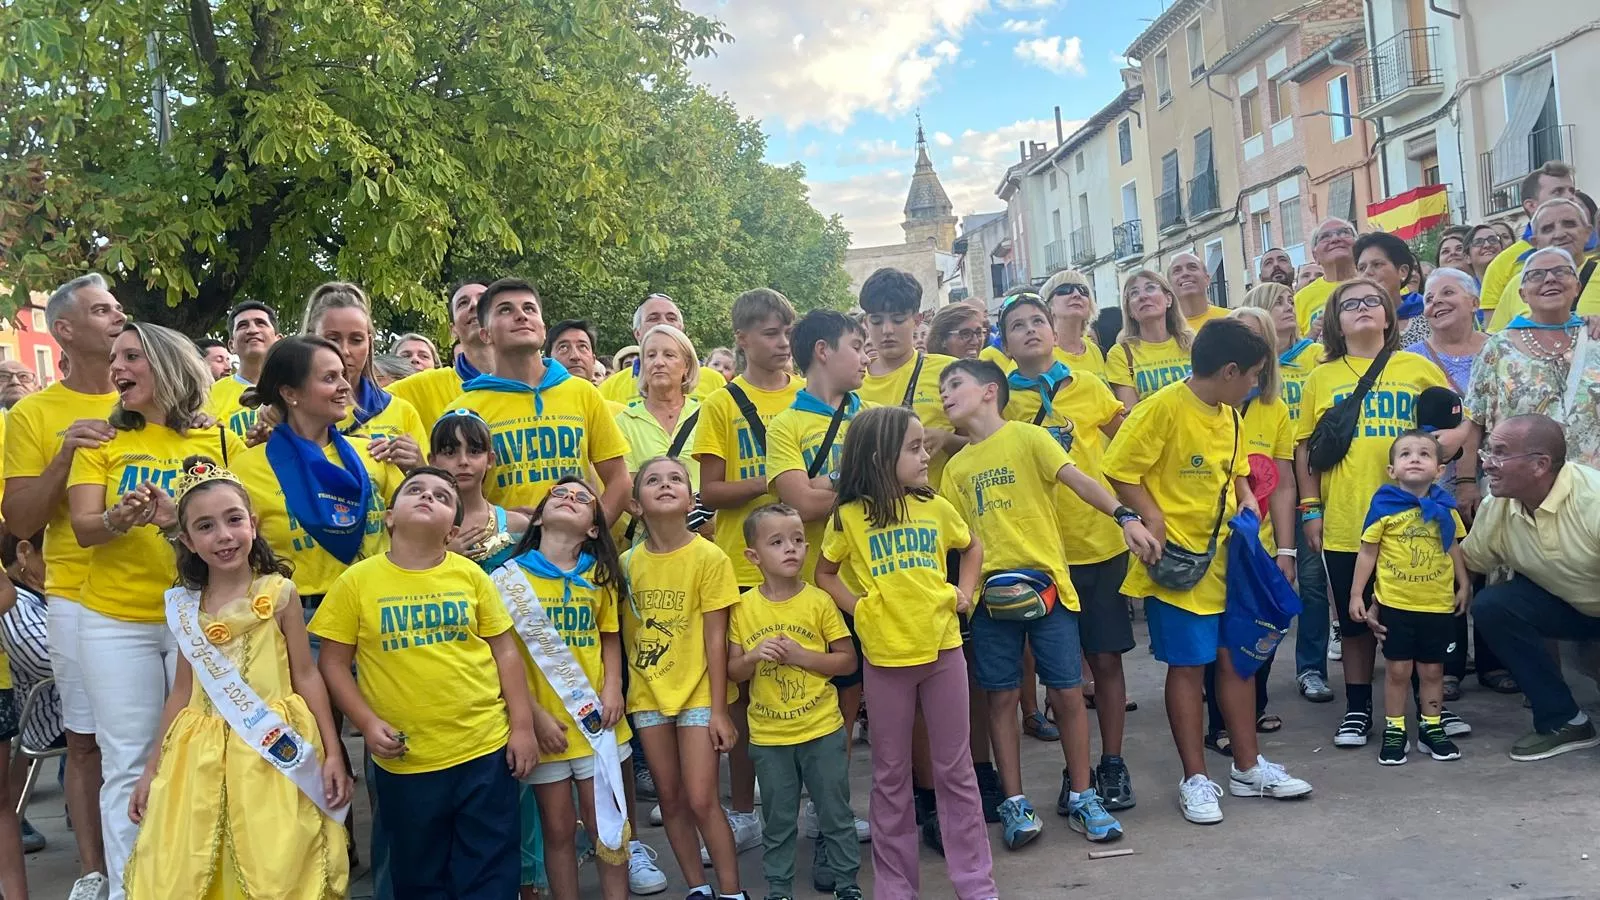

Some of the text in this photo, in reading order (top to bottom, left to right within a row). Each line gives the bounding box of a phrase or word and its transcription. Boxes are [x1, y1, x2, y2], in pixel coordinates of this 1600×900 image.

[517, 415, 557, 423] FIESTAS
[403, 592, 442, 601] FIESTAS
[746, 623, 817, 645] FIESTAS DE AYERBE
[223, 681, 255, 712] 2026
